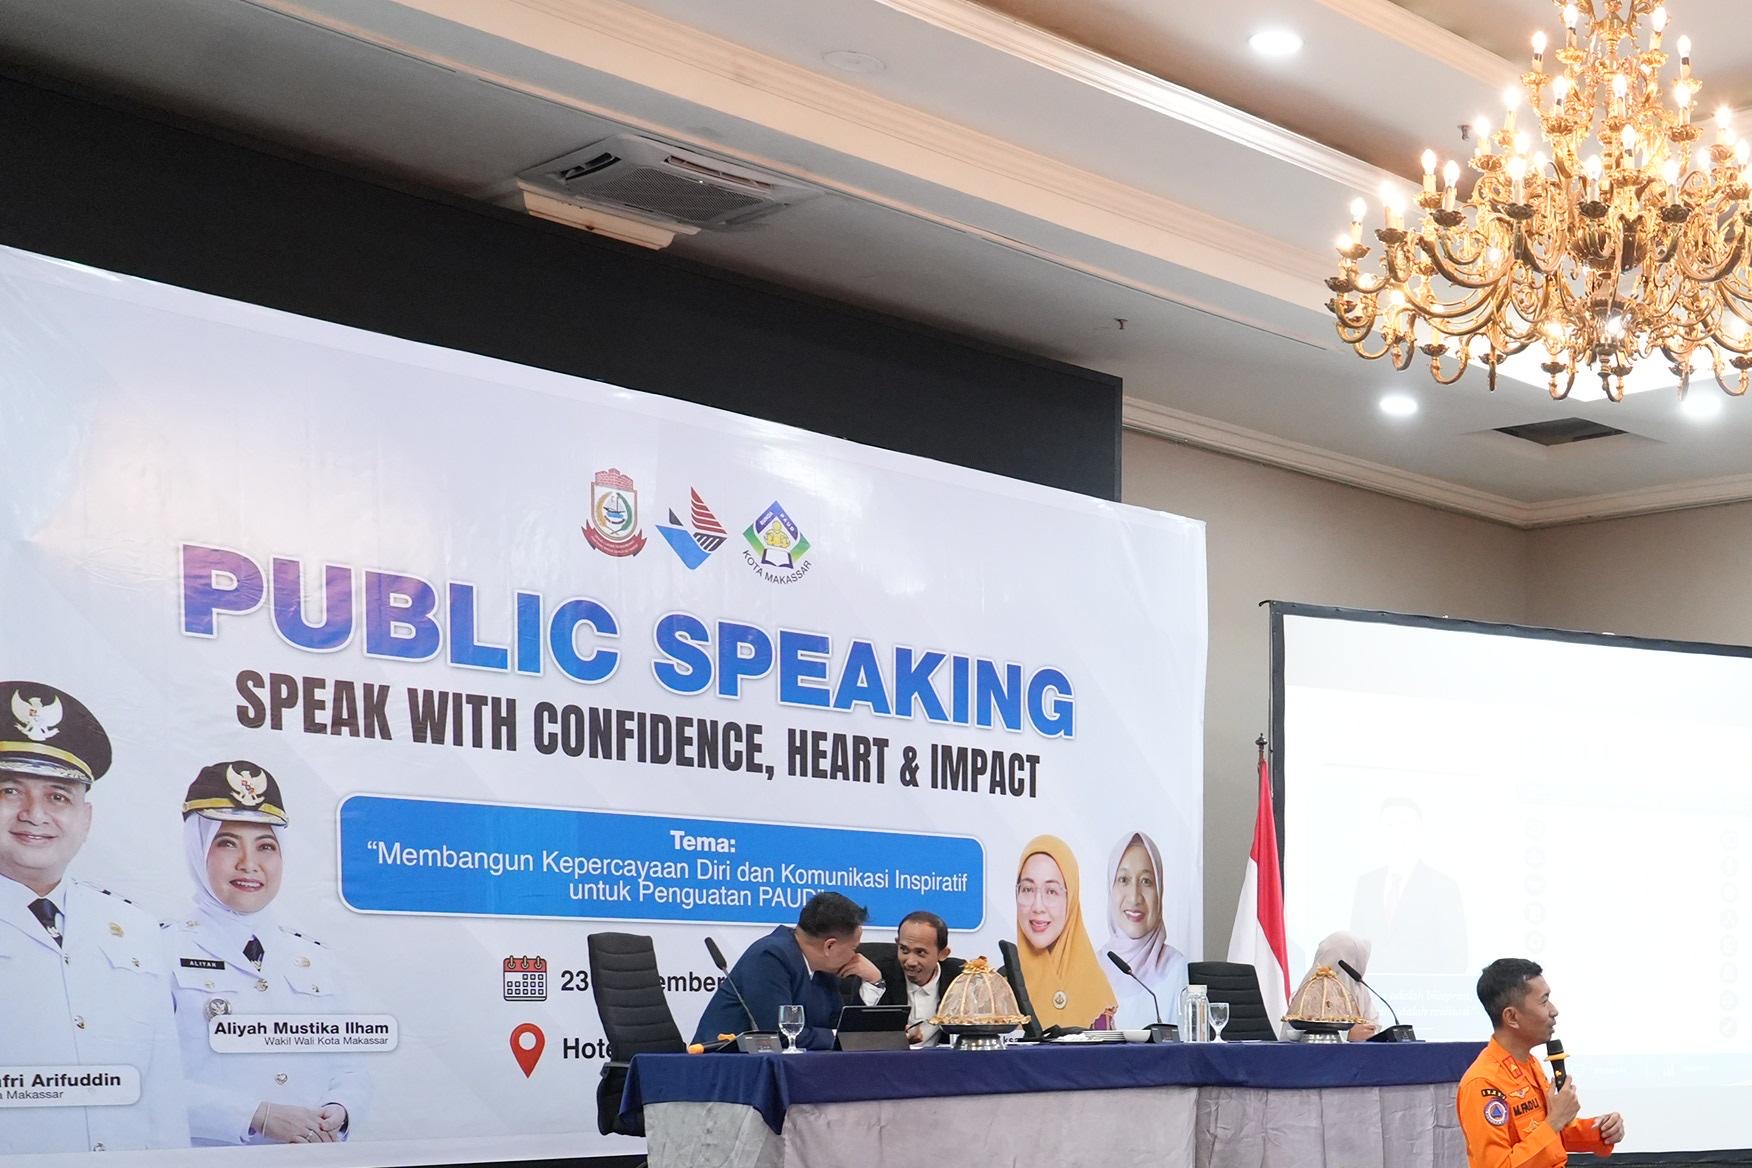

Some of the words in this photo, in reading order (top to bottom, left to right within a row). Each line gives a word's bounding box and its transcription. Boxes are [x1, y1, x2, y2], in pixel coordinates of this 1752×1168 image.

[742, 550, 763, 577] KOTA
[764, 560, 812, 585] MAKASSAR
[180, 542, 621, 685] PUBLIC
[651, 611, 1076, 739] SPEAKING
[235, 669, 393, 742] SPEAK
[407, 686, 518, 752] WITH
[532, 701, 775, 781] CONFIDENCE,
[787, 728, 889, 785] HEART
[899, 745, 921, 788] &
[930, 743, 1041, 799] IMPACT
[669, 829, 736, 854] Tema:
[542, 850, 690, 882] Kepercayaan
[696, 858, 732, 881] Diri
[736, 861, 775, 883] dan
[780, 863, 890, 889] Komunikasi
[895, 869, 969, 895] Inspiratif
[569, 880, 632, 902] untuk
[638, 880, 752, 907] Penguatan
[560, 969, 590, 992] 23
[659, 971, 728, 992] ember
[214, 1021, 268, 1037] Aliyah
[273, 1021, 340, 1035] Mustika
[345, 1021, 389, 1035] Ilham
[264, 1036, 292, 1046] Wakil
[295, 1036, 315, 1046] Wali
[317, 1036, 341, 1045] Kota
[343, 1036, 389, 1045] Makassar
[0, 1074, 24, 1088] fri
[31, 1073, 121, 1088] Arifuddin
[6, 1090, 64, 1100] Makassar
